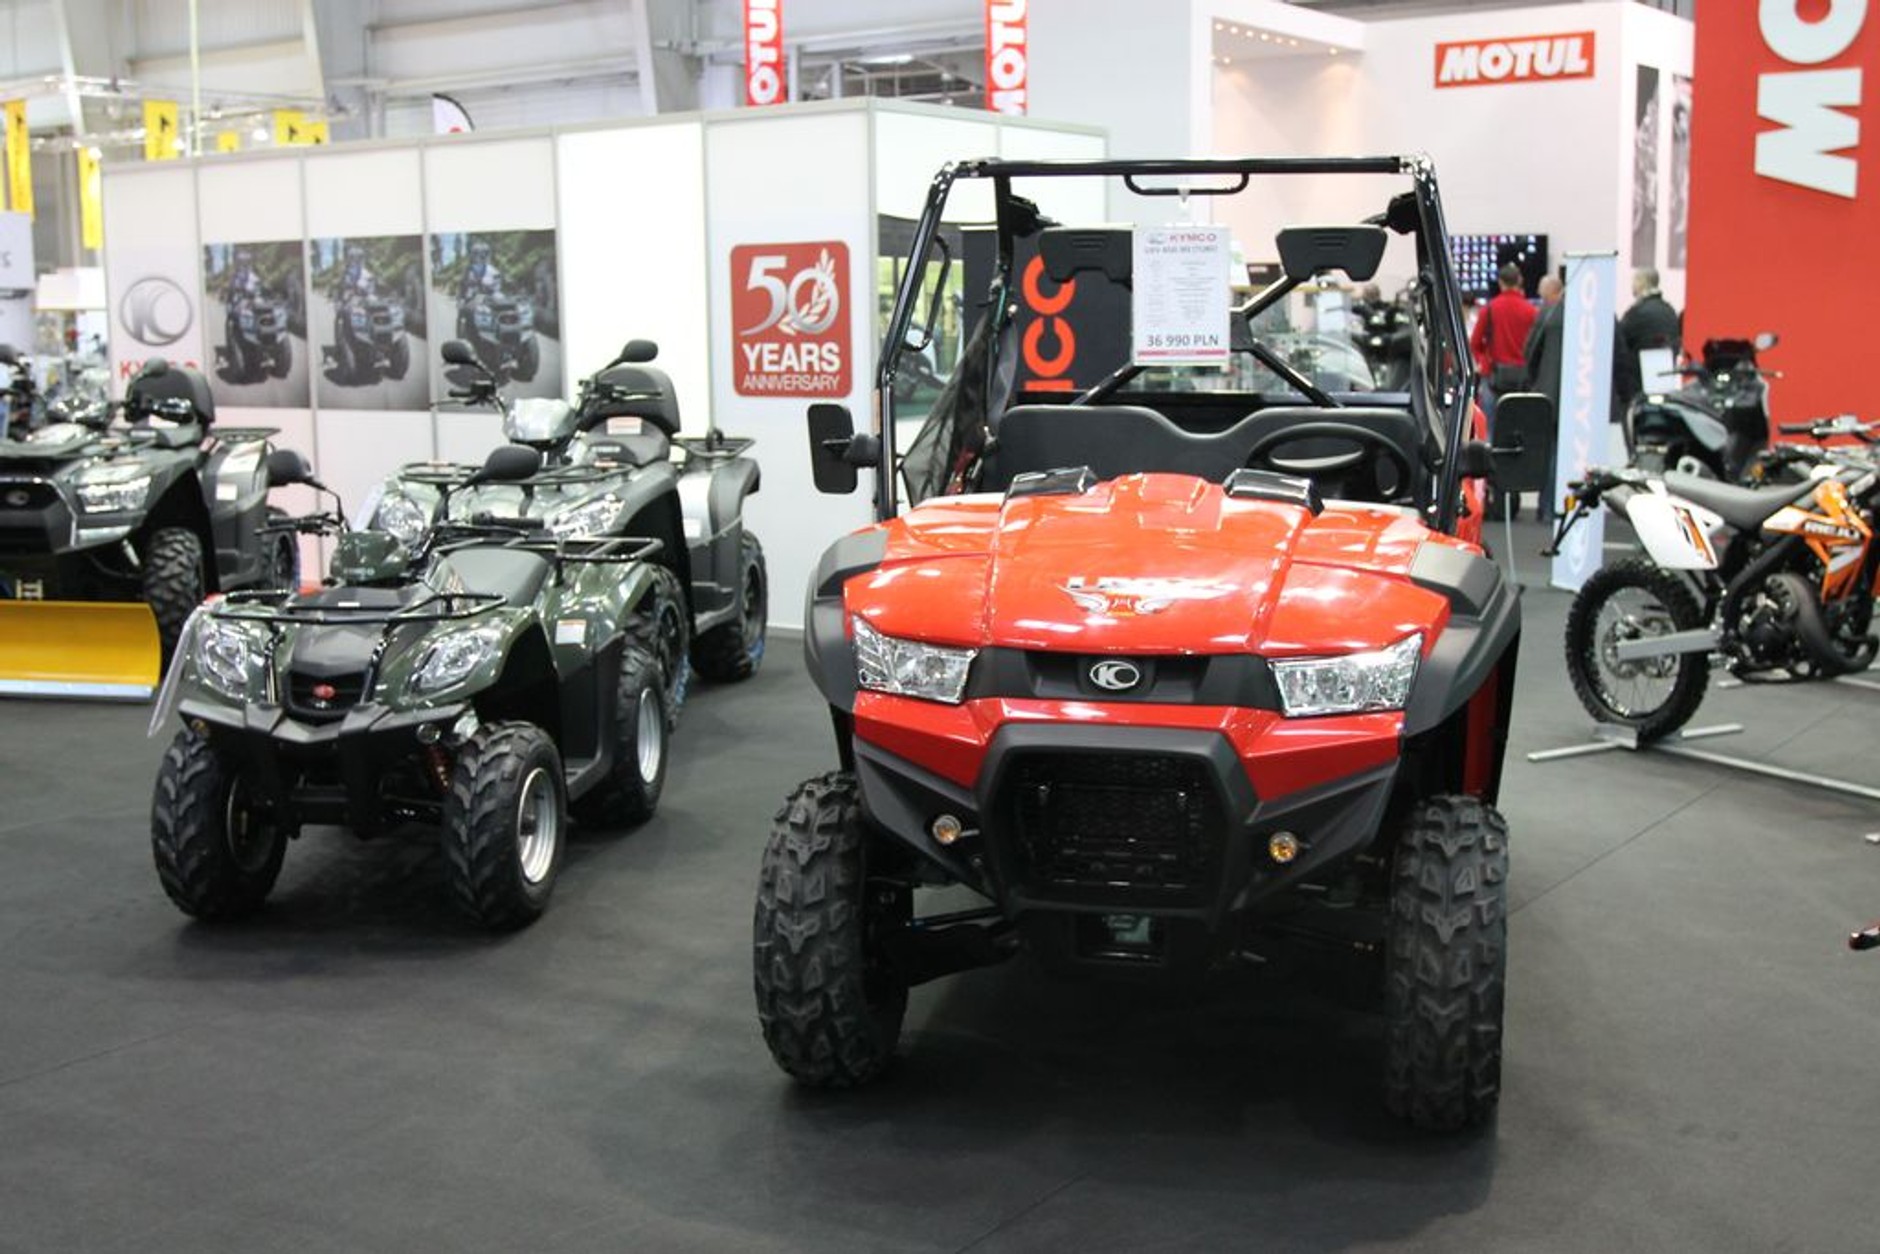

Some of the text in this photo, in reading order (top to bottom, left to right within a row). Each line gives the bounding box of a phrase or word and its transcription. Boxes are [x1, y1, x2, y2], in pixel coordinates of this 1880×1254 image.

[1439, 37, 1588, 82] MOTUL
[739, 255, 840, 336] 50
[1147, 334, 1219, 347] 36 990 PLN
[742, 341, 841, 373] YEARS
[742, 374, 840, 391] ANNIVERSARY
